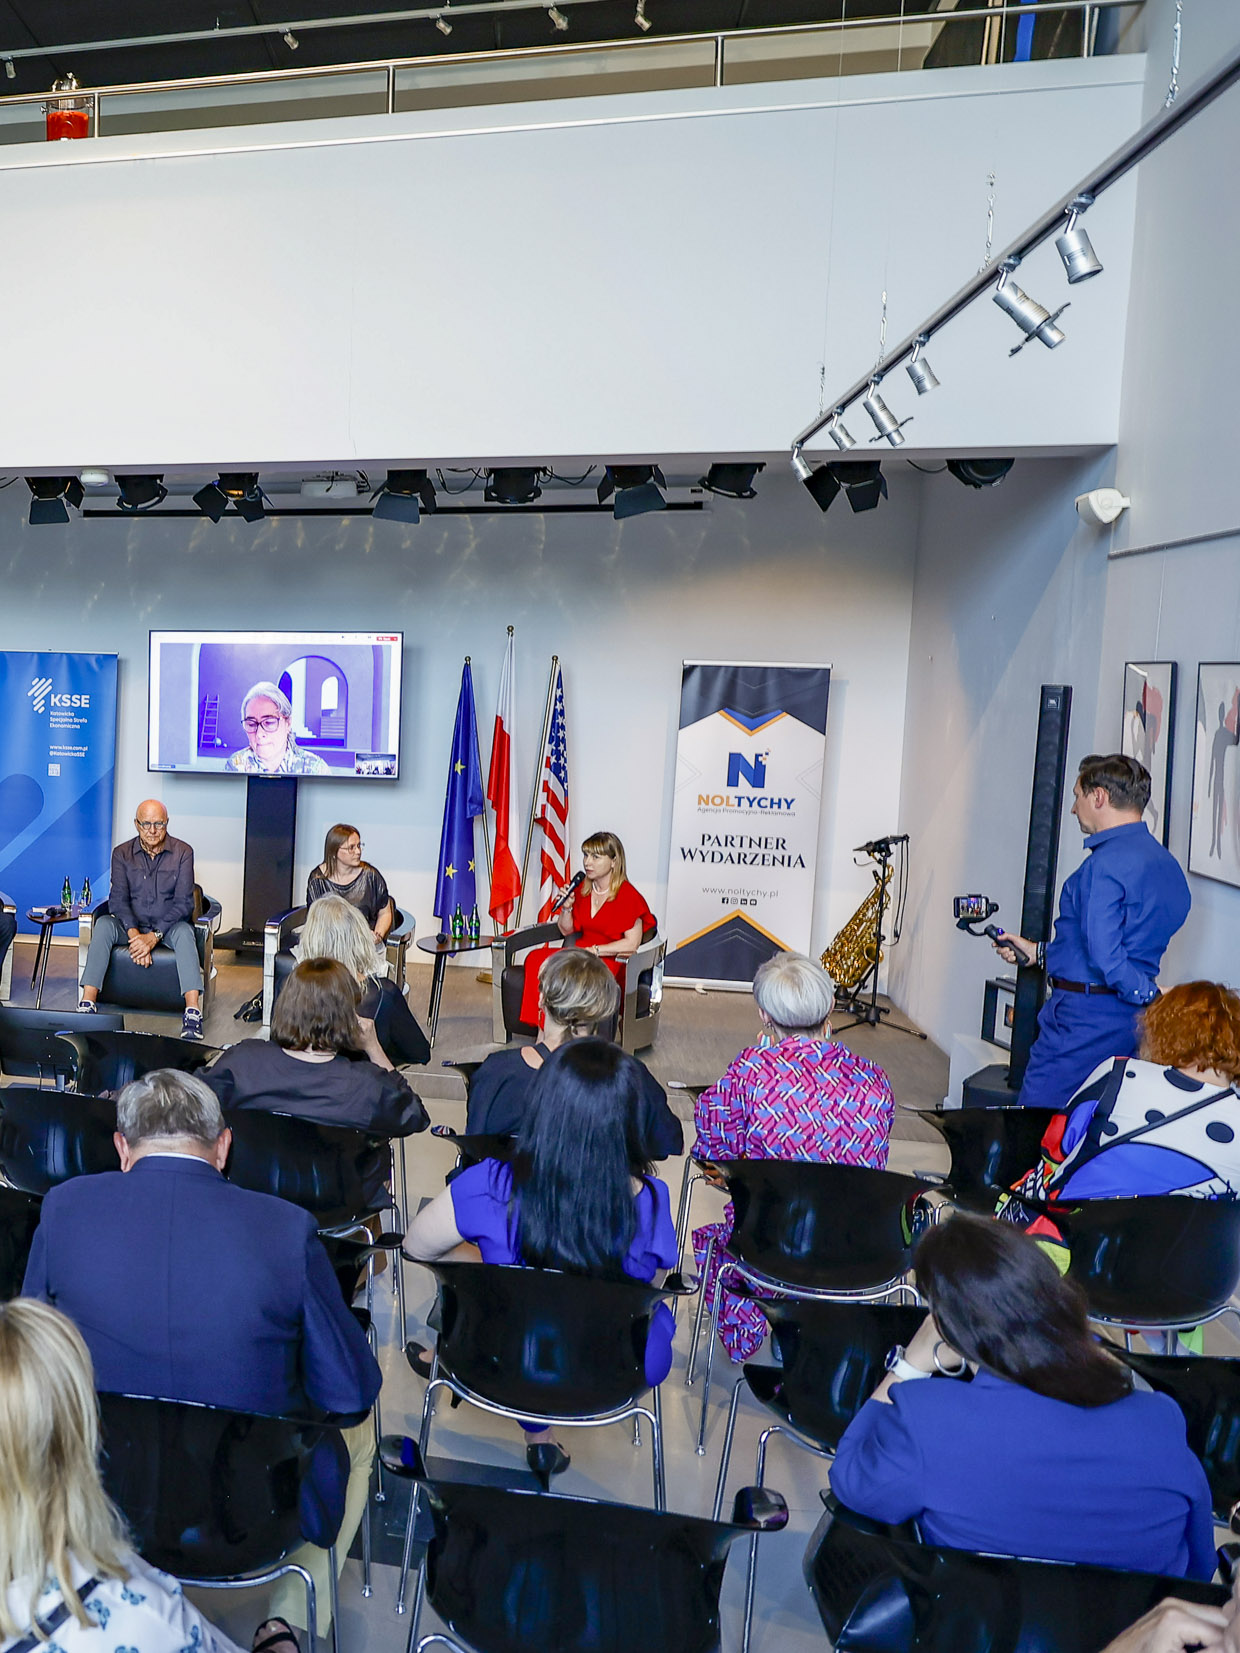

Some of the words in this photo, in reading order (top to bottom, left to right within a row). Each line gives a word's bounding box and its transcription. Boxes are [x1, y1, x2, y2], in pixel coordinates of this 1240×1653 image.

[50, 693, 90, 708] KSSE
[697, 794, 796, 810] NOLTYCHY
[697, 806, 722, 814] Agencja
[701, 833, 787, 851] PARTNER
[680, 847, 806, 869] WYDARZENIA
[702, 886, 779, 899] www.noltychy.pl
